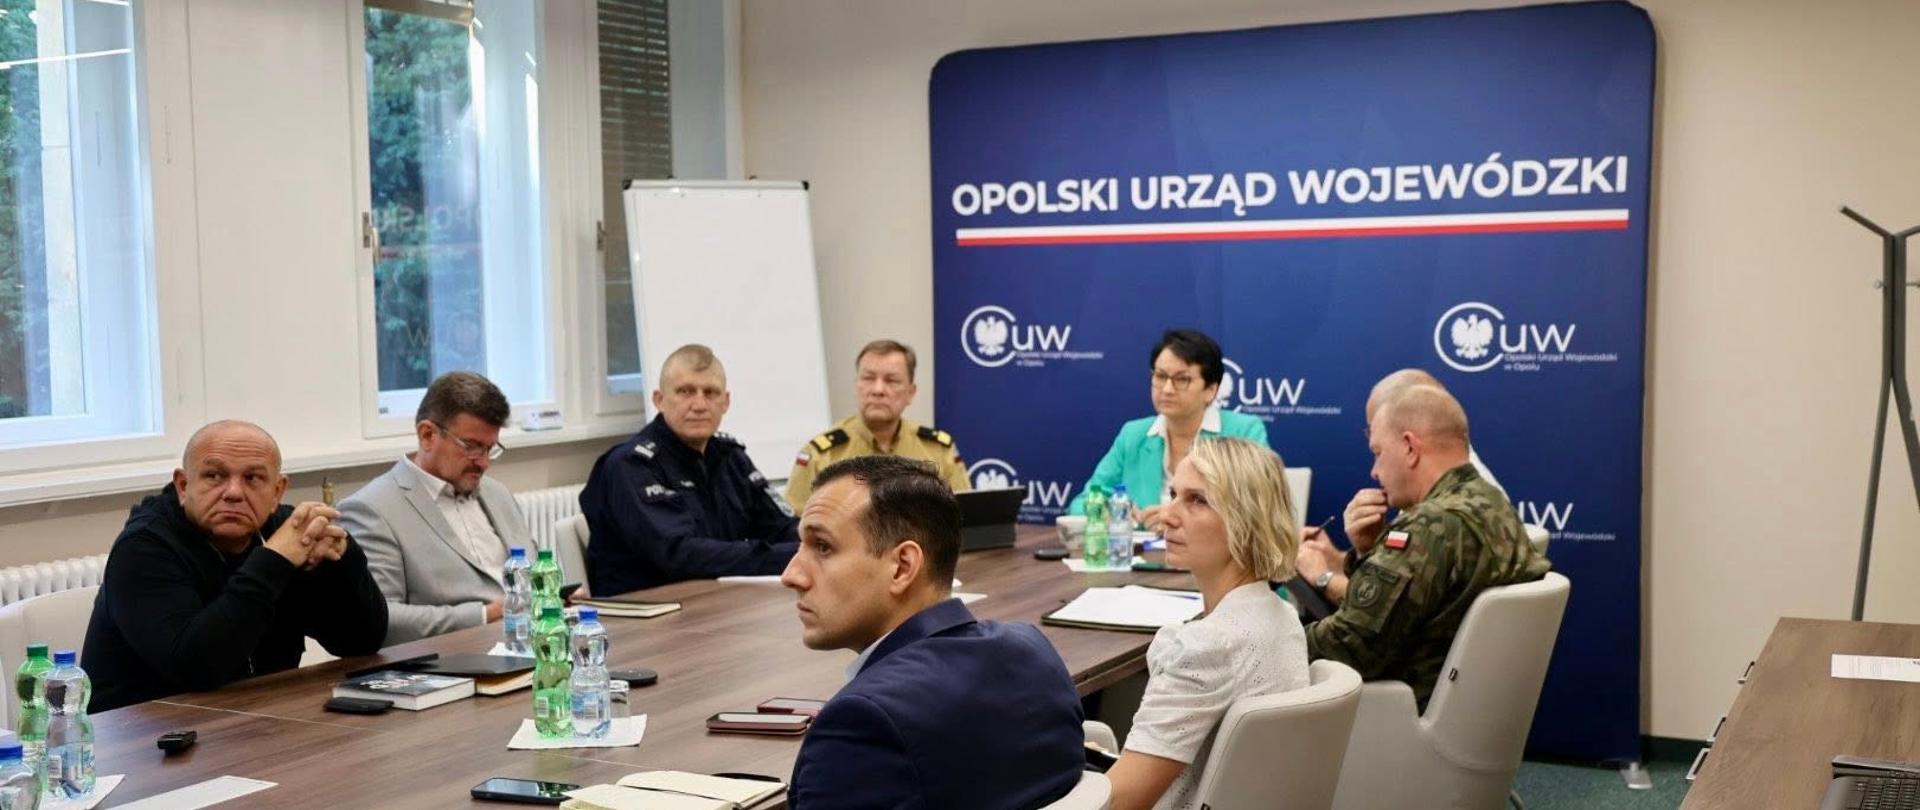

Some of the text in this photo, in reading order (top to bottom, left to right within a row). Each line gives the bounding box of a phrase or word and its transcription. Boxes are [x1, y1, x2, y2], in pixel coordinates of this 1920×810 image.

[952, 152, 1629, 216] OPOLSKI URZĄD WOJEWÓDZKI
